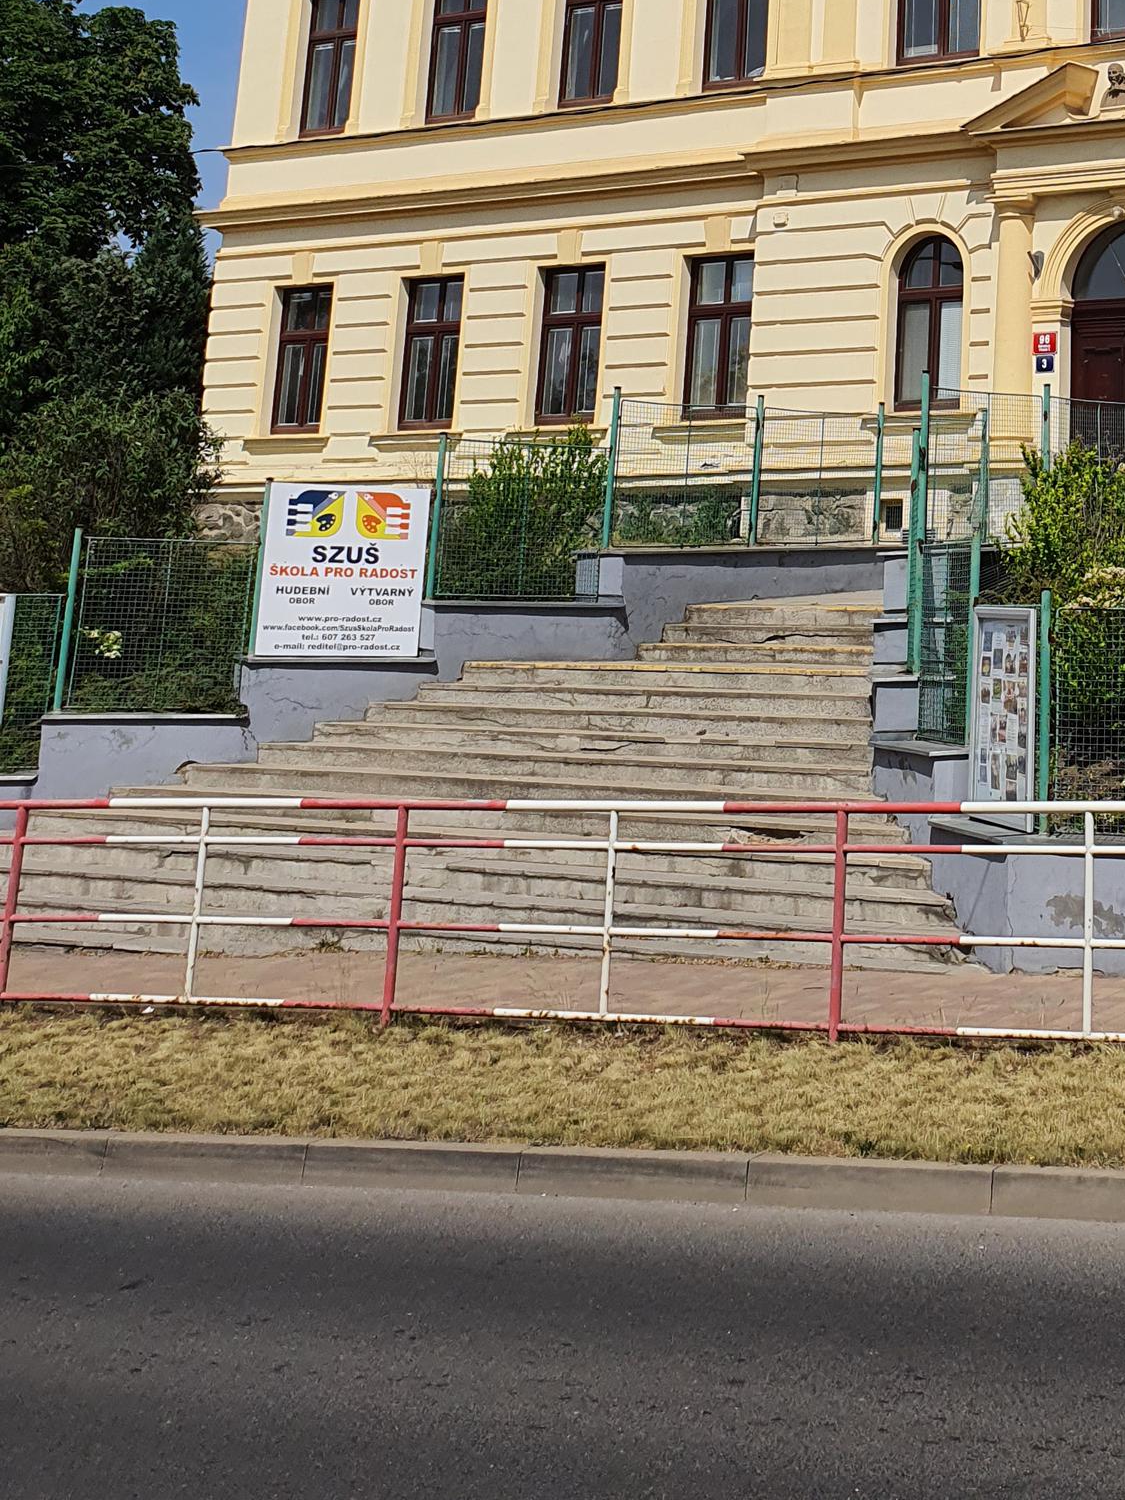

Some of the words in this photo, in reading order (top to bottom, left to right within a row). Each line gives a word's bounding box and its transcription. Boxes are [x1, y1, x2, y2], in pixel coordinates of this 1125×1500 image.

[1039, 334, 1050, 344] 96
[1041, 358, 1047, 368] 3
[311, 542, 380, 565] SZUŠ
[269, 563, 319, 577] ŠKOLA
[324, 566, 354, 578] PRO
[359, 566, 418, 579] RADOST
[275, 585, 330, 595] HUDEBNÍ
[350, 586, 415, 597] VÝTVARNÝ
[288, 597, 316, 605] OBOR
[368, 598, 394, 606] OBOR
[298, 615, 382, 623] www.pro-radost.cz
[302, 633, 319, 641] tel.:
[321, 633, 338, 641] 607
[359, 634, 376, 642] 527
